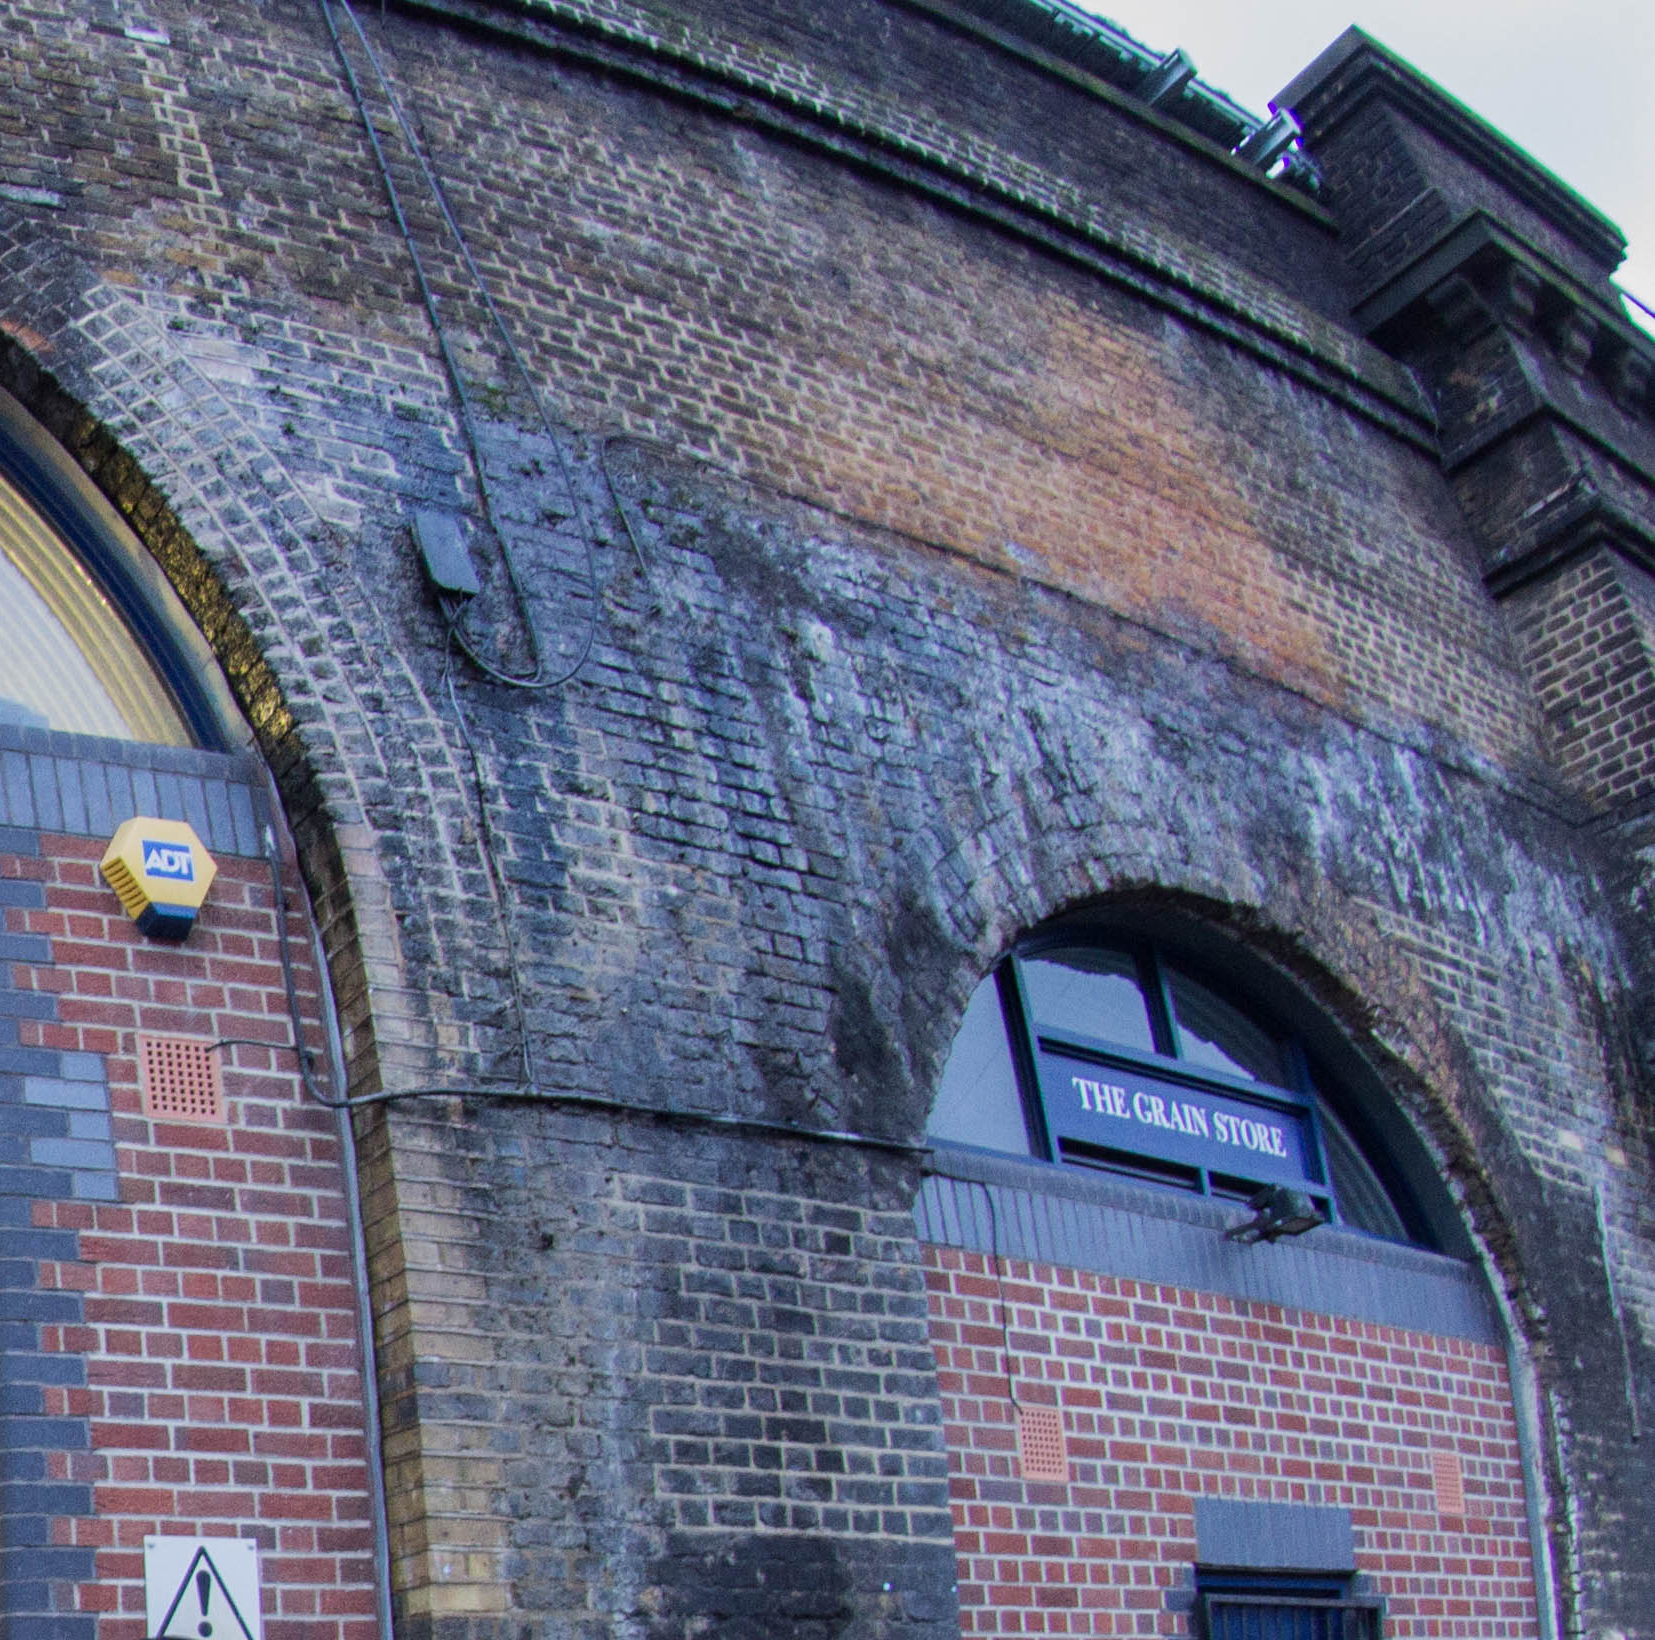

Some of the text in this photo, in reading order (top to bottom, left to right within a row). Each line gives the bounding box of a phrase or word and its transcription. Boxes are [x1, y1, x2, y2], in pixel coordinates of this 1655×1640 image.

[145, 847, 191, 875] ADT
[1072, 1076, 1287, 1158] THE GRAIN STORE
